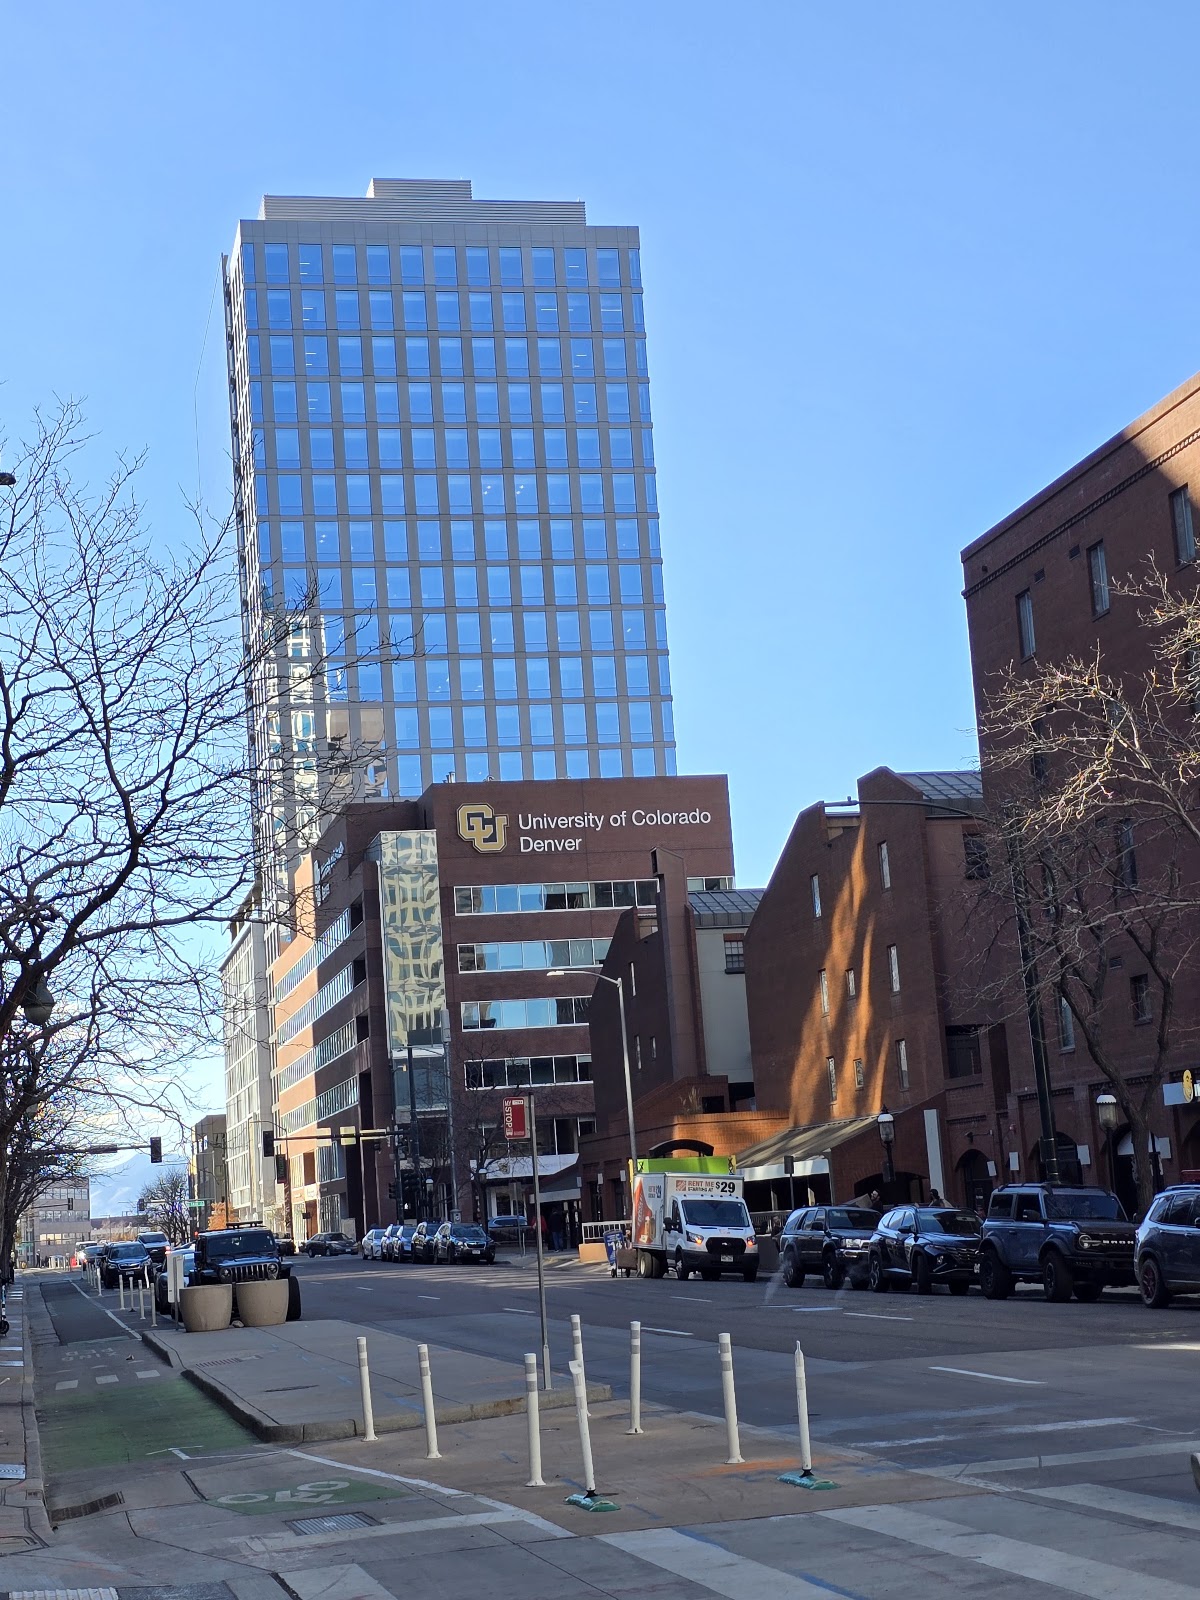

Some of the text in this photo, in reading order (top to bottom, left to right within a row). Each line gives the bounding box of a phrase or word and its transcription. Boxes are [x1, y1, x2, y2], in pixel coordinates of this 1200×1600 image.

[518, 808, 712, 831] University of Colorado
[520, 836, 582, 853] Denver
[505, 1106, 513, 1128] STOP
[715, 1181, 736, 1193] $29
